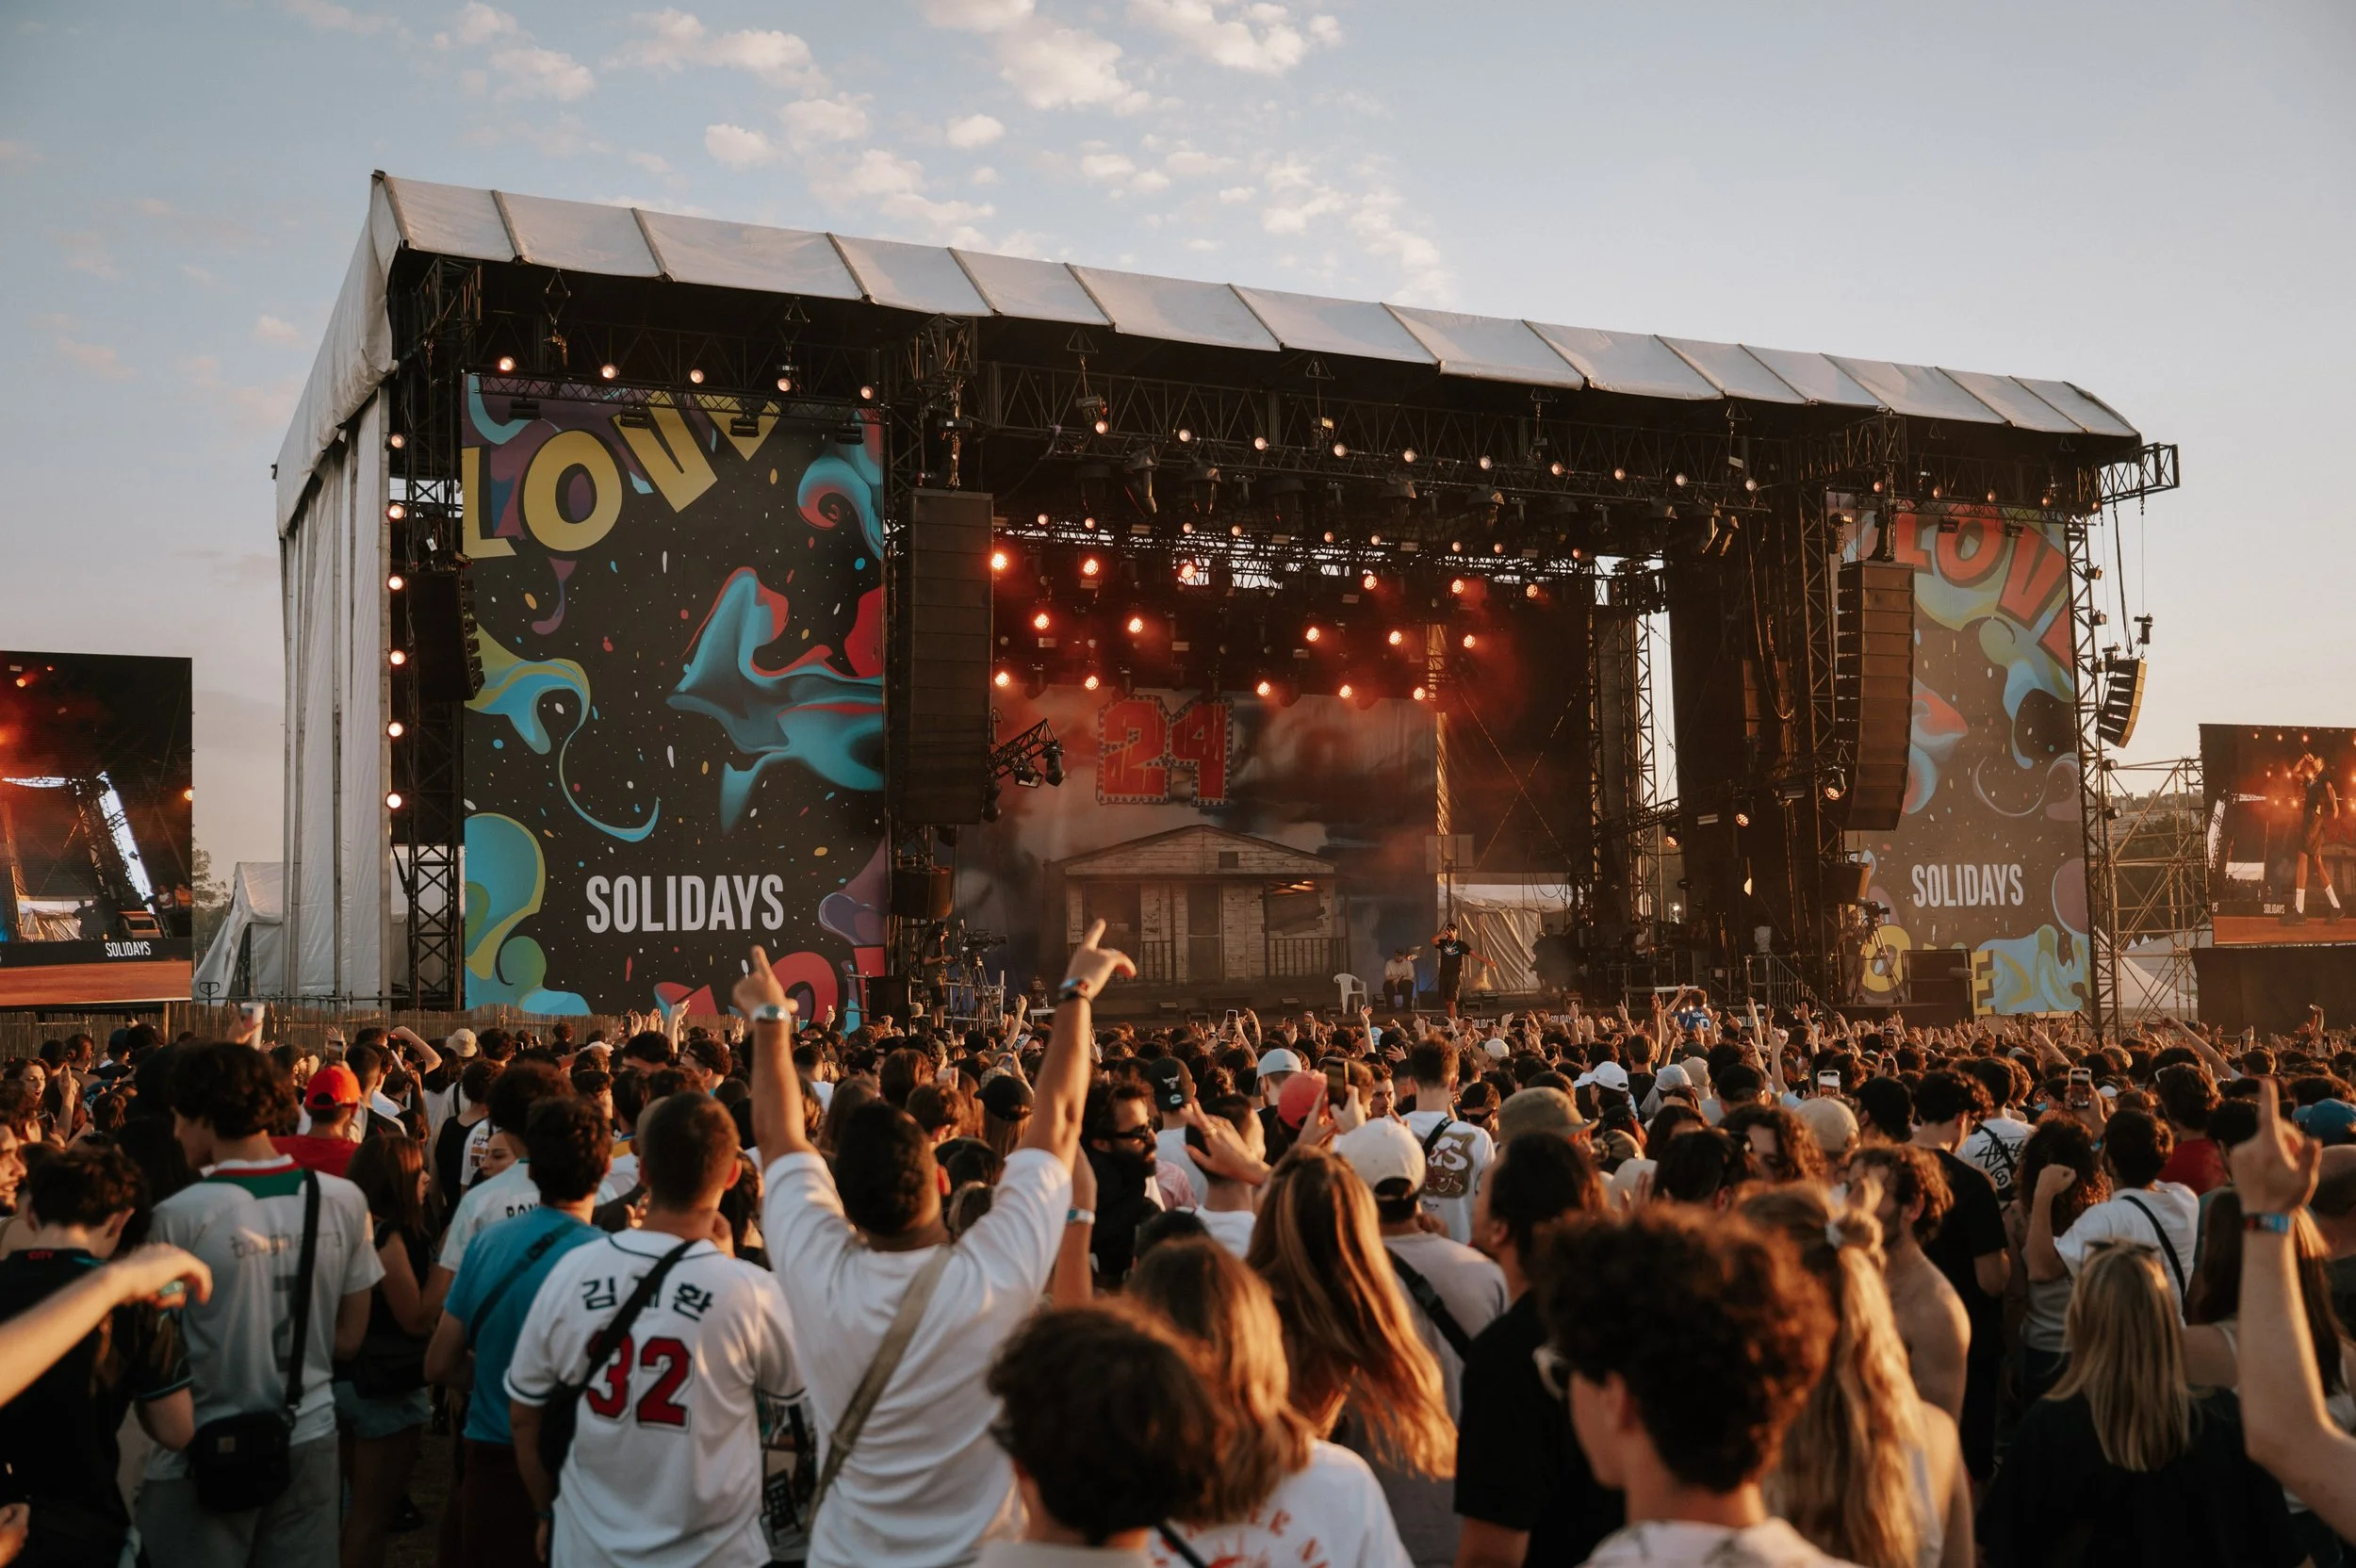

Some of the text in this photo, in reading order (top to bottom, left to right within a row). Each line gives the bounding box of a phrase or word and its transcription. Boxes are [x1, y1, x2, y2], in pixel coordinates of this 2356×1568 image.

[1096, 694, 1234, 808] 24
[585, 874, 784, 934] SOLIDAYS
[1911, 863, 2024, 907] SOLIDAYS
[2263, 903, 2284, 914] SOLIDAYS
[105, 941, 151, 957] SOLIDAYS
[586, 1330, 694, 1433] 32
